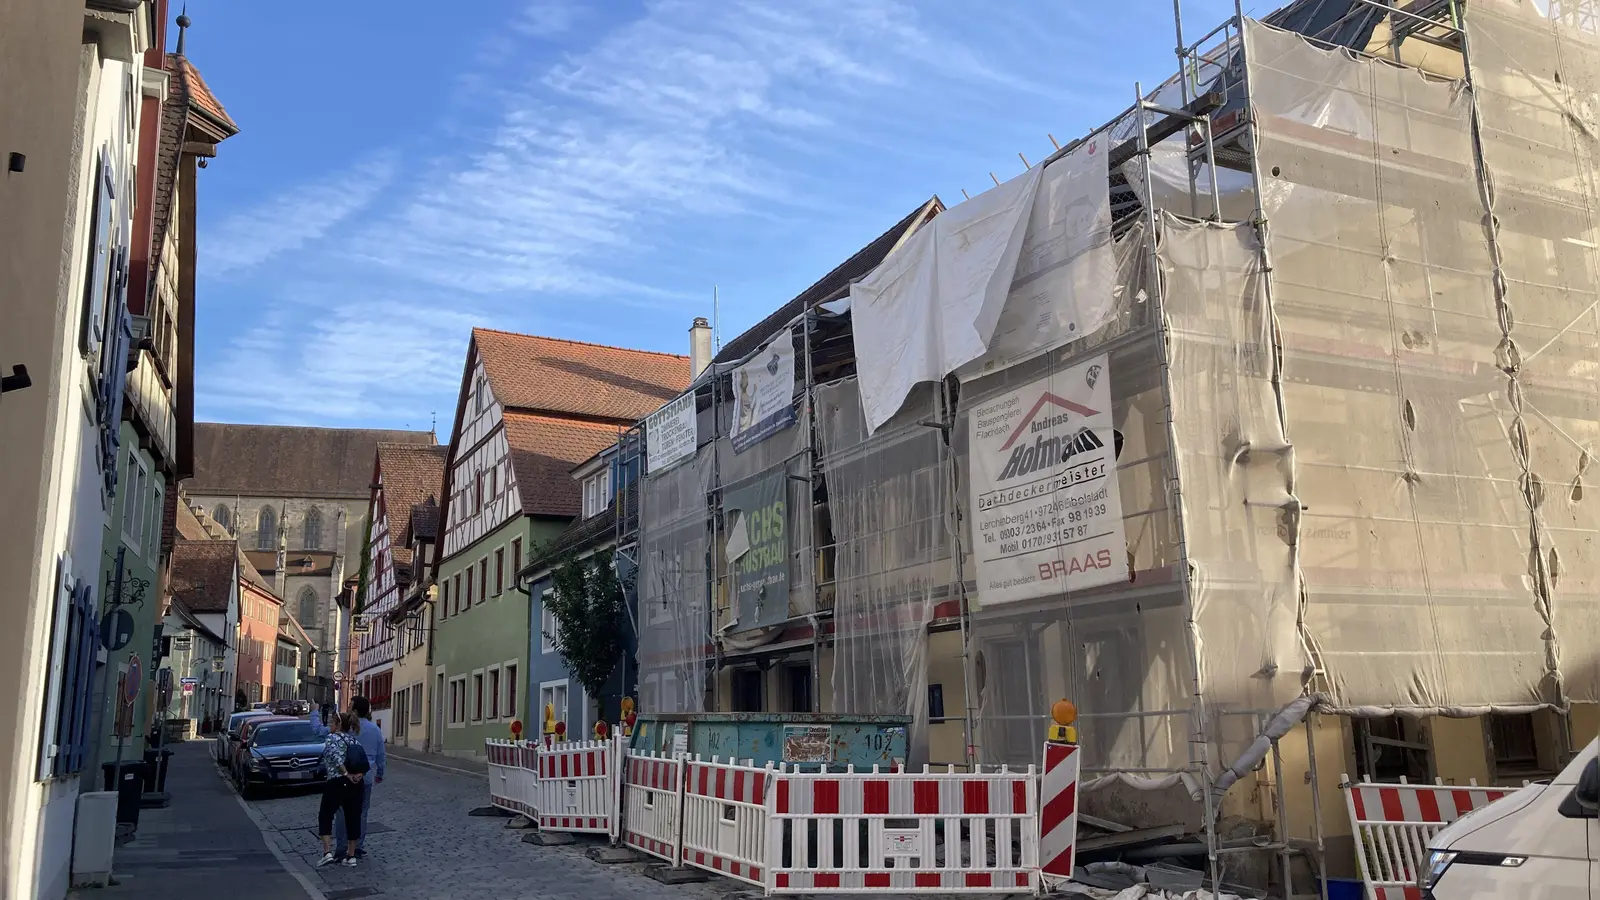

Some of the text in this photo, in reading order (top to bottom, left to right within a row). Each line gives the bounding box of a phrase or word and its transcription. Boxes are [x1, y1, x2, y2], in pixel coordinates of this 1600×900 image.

[648, 392, 694, 430] GOTTSMANN
[976, 395, 1020, 418] Bedachungen
[976, 423, 1010, 439] Flachdach
[1030, 412, 1069, 434] Andreas
[996, 426, 1105, 481] Hofmann
[978, 463, 1106, 509] Dachdeckermeister
[1051, 517, 1065, 528] Fax
[1000, 540, 1019, 554] Mobil
[1038, 549, 1112, 580] BRAAS
[864, 733, 892, 751] 102
